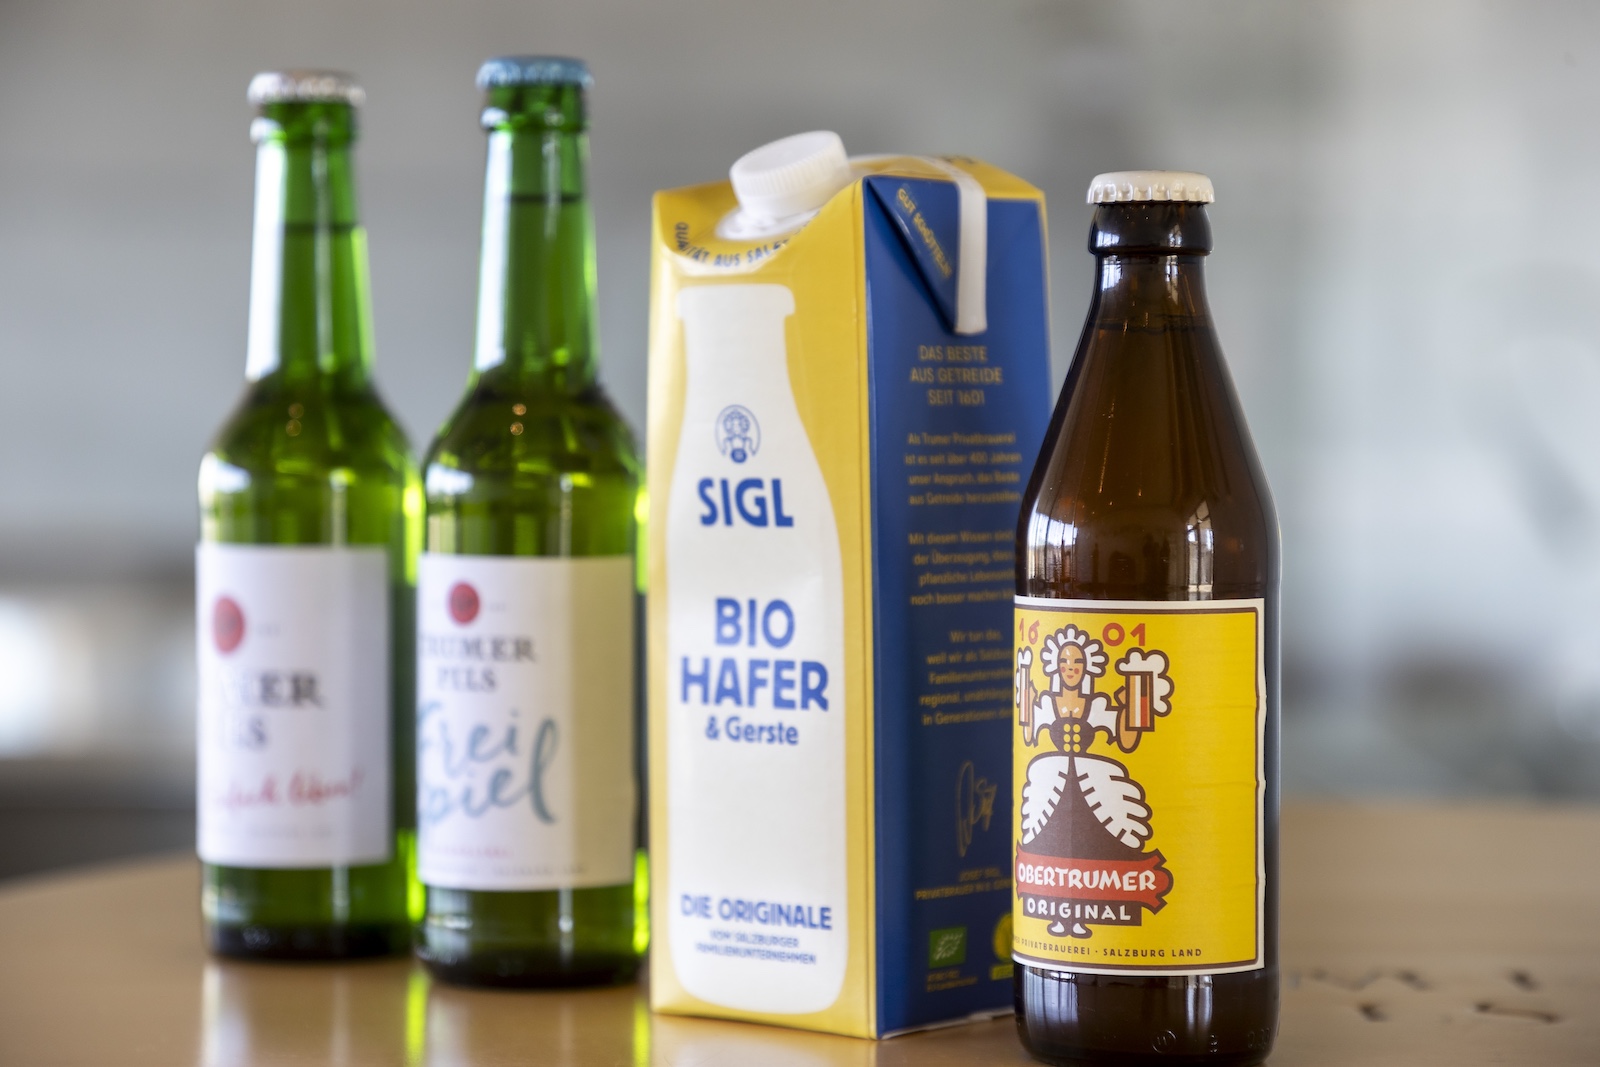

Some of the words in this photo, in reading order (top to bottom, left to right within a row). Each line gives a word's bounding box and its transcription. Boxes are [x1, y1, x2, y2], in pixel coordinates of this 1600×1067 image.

[896, 188, 916, 214] GUT
[713, 252, 740, 267] AUS
[919, 345, 943, 362] DAS
[949, 345, 988, 363] BESTE
[910, 367, 935, 383] AUS
[938, 366, 1003, 384] GETREIDE
[928, 389, 953, 405] SEIT
[697, 476, 795, 528] SIGL
[715, 597, 796, 650] BIO
[1018, 617, 1040, 645] 16
[1102, 622, 1146, 647] 01
[681, 656, 830, 712] HAFER
[705, 715, 720, 741] &
[725, 716, 800, 746] Gerste
[1018, 863, 1157, 892] OBERTRUMER
[681, 893, 712, 919] DIE
[718, 898, 833, 931] ORIGINALE
[1027, 897, 1132, 921] ORIGINAL
[1021, 938, 1091, 956] PRIVATBRAUEREI
[1103, 948, 1165, 958] SALZBURG
[1172, 948, 1202, 958] LAND
